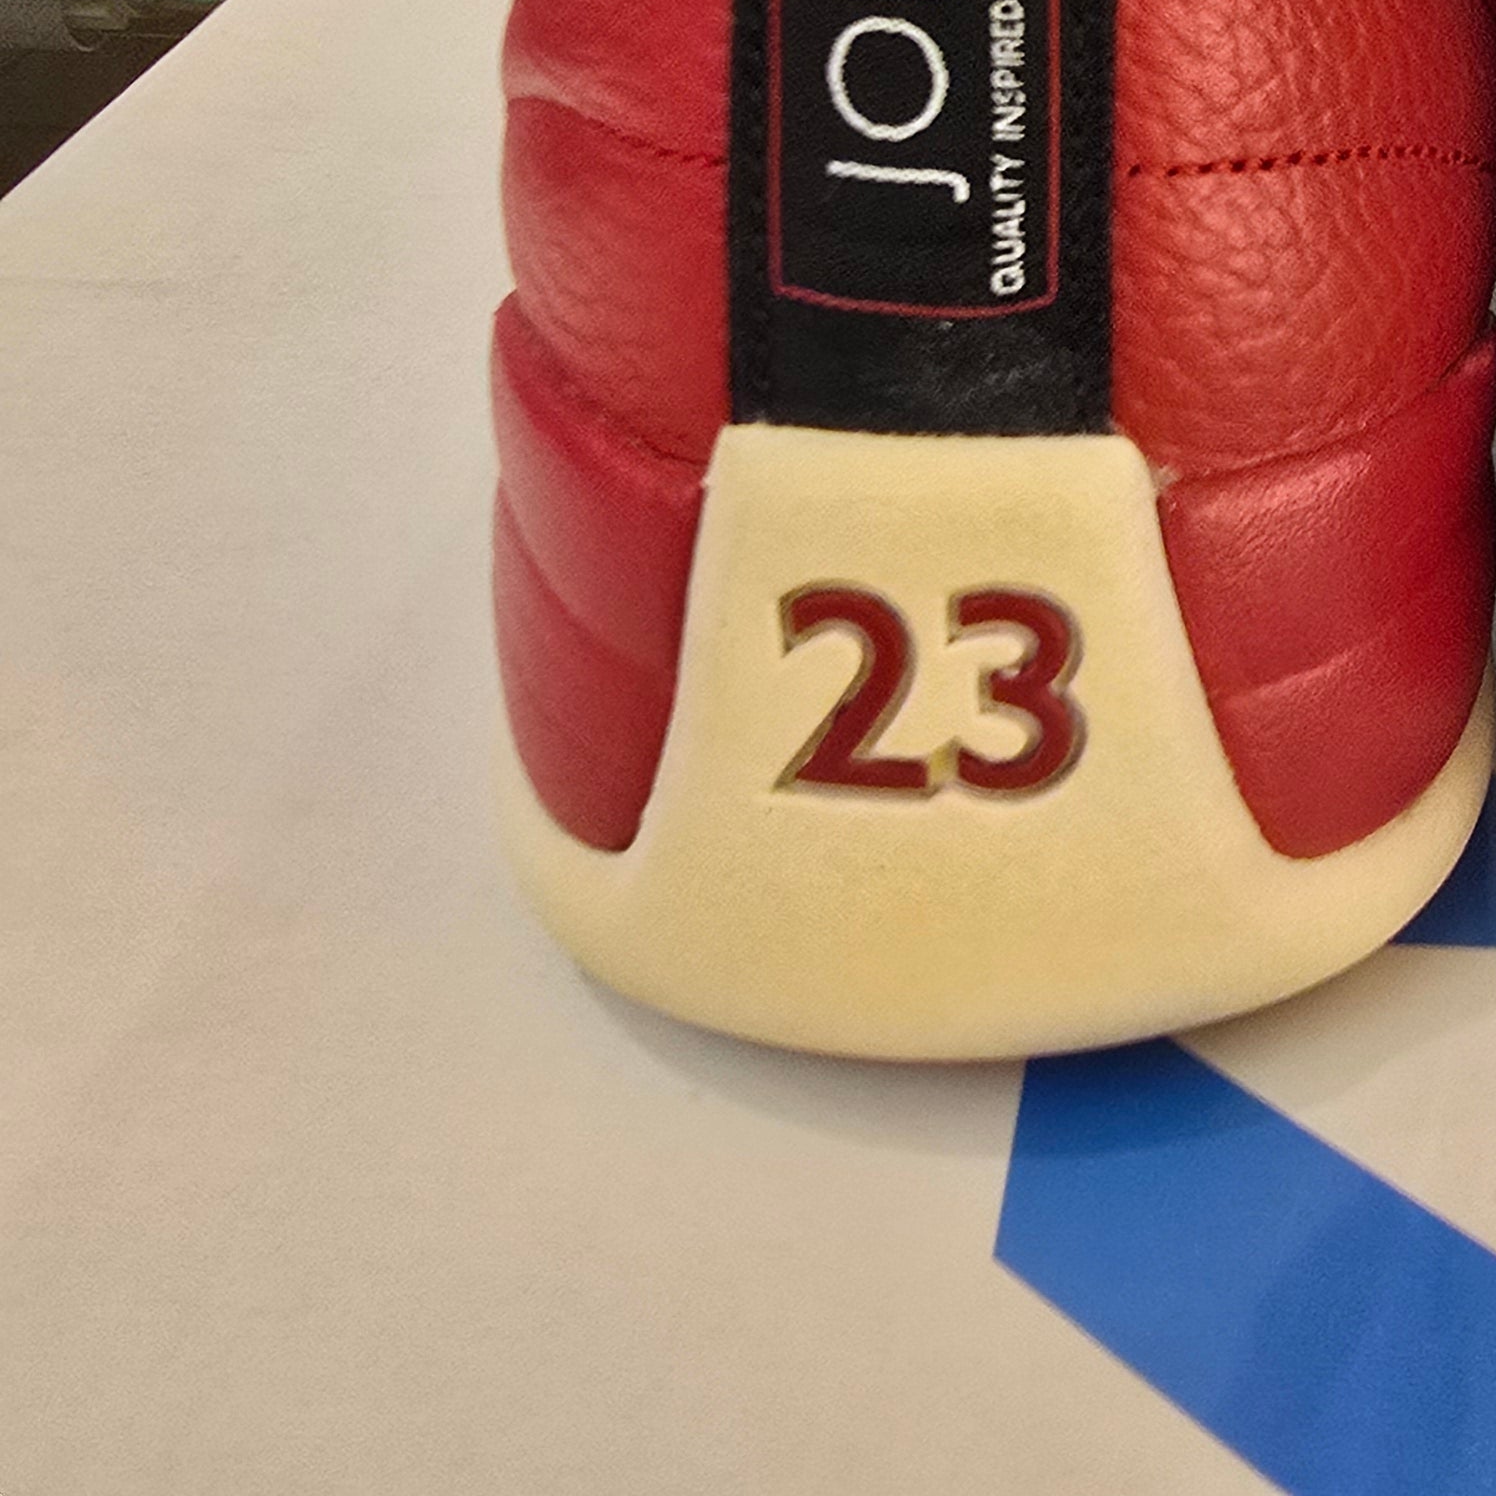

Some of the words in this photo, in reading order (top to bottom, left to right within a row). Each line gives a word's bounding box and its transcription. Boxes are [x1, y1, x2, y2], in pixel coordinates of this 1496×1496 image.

[989, 0, 1026, 141] INSPIRED
[989, 153, 1026, 295] QUALITY
[772, 578, 1090, 804] 23
